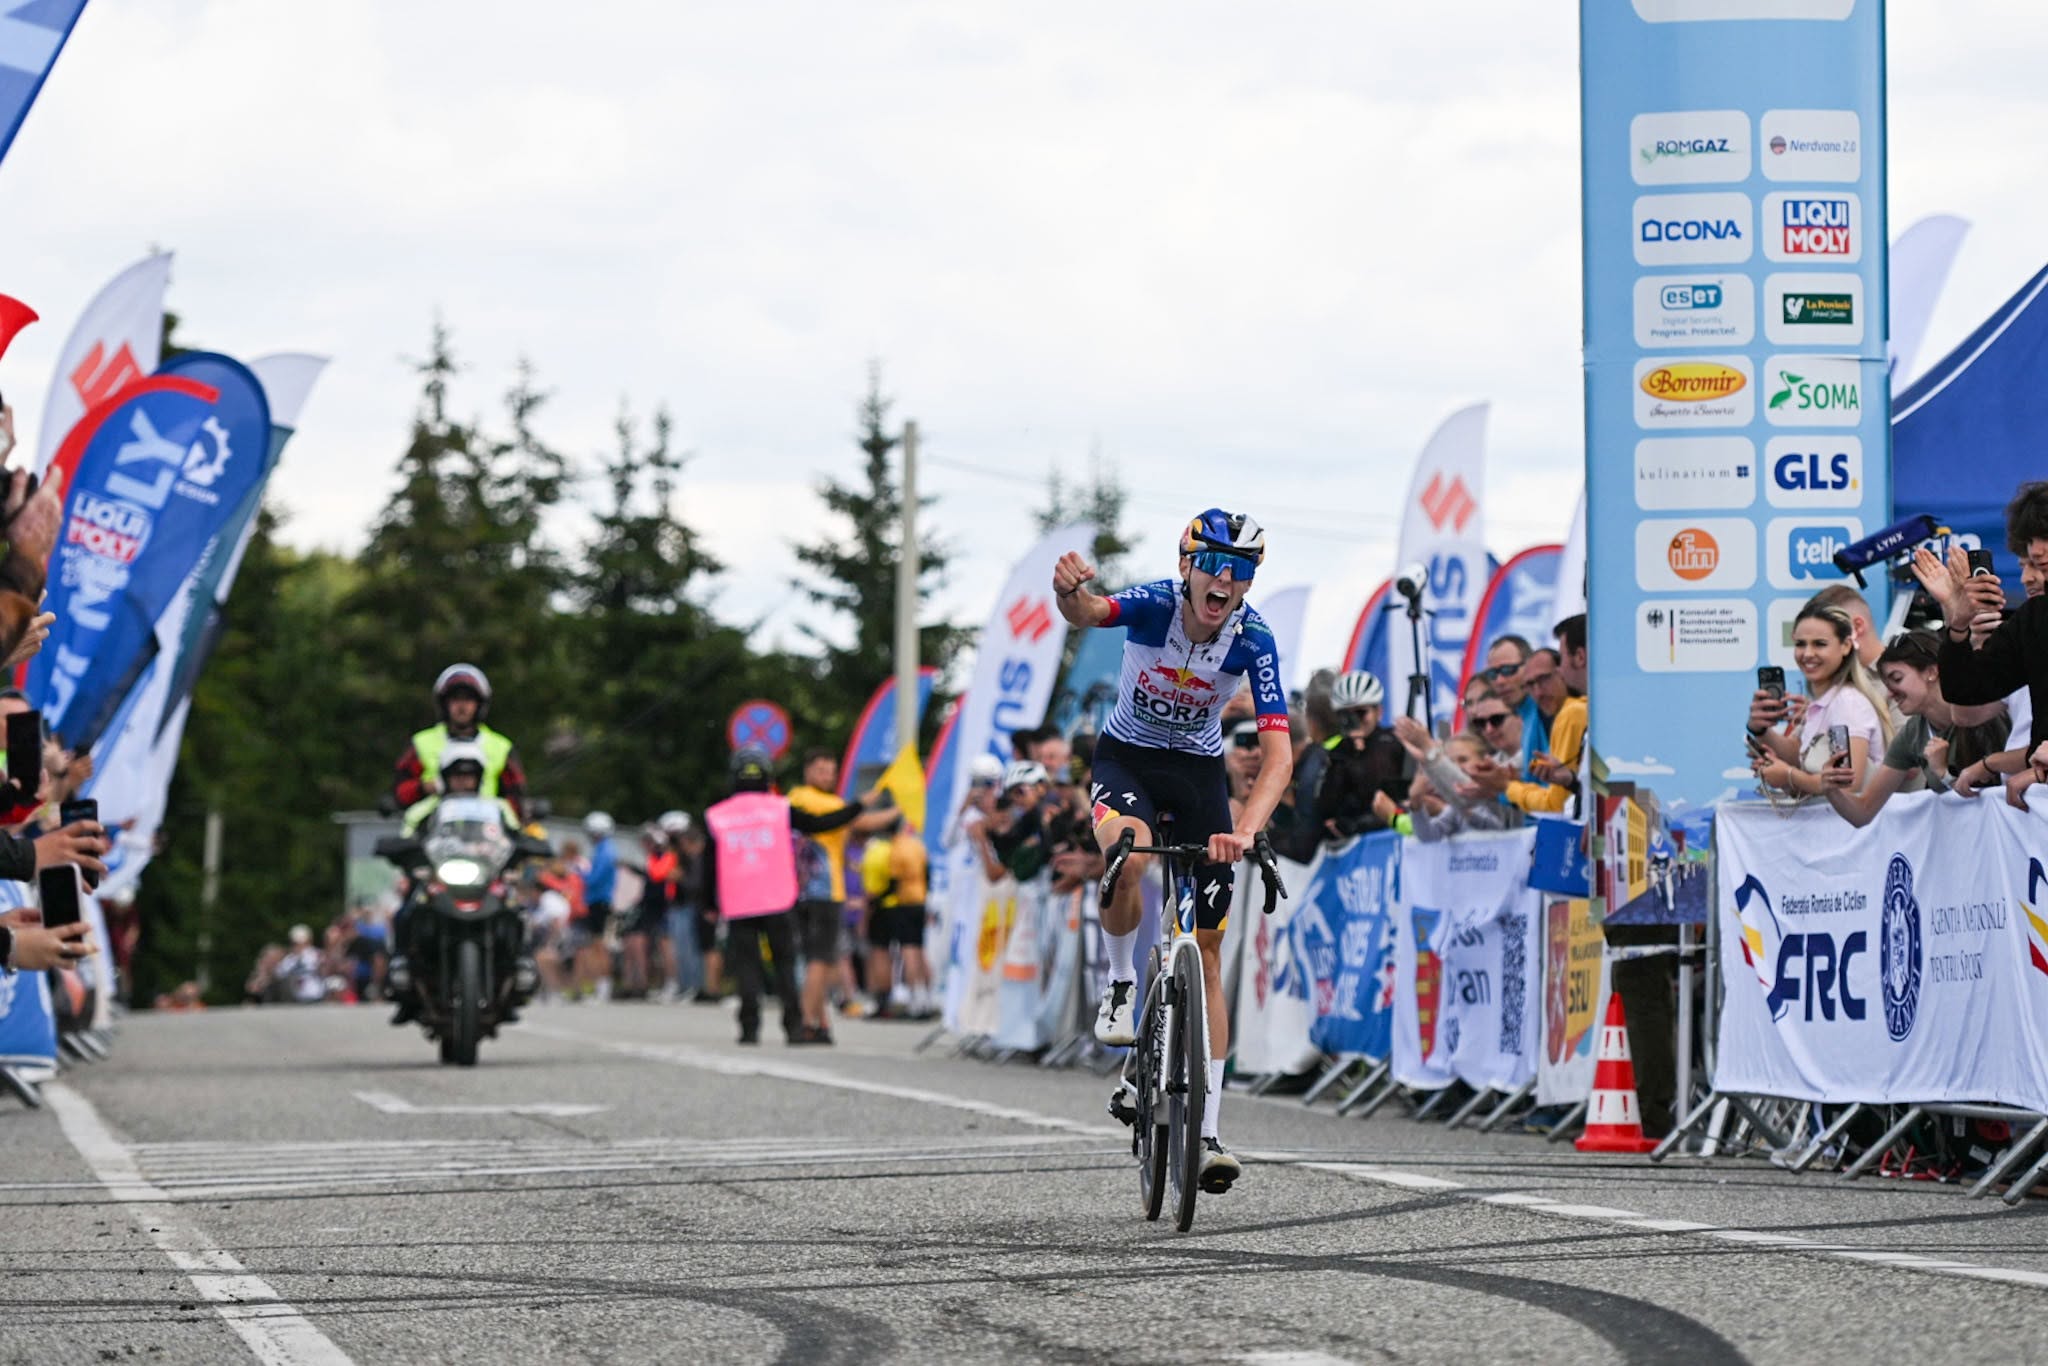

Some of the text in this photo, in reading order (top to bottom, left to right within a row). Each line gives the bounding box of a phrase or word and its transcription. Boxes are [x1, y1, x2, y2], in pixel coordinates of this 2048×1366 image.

[1656, 138, 1730, 153] ROMGAZ
[1786, 201, 1848, 227] LIQUI
[1786, 228, 1850, 253] MOLY
[1649, 368, 1737, 393] Boromir
[1798, 383, 1859, 409] SOMA
[1639, 466, 1730, 479] kulinarium
[1671, 533, 1716, 570] ifm
[1876, 530, 1905, 552] LYNX
[1138, 670, 1178, 701] Red
[1256, 653, 1279, 704] BOSS
[1133, 686, 1209, 721] BORA
[1768, 931, 1867, 1022] FRC
